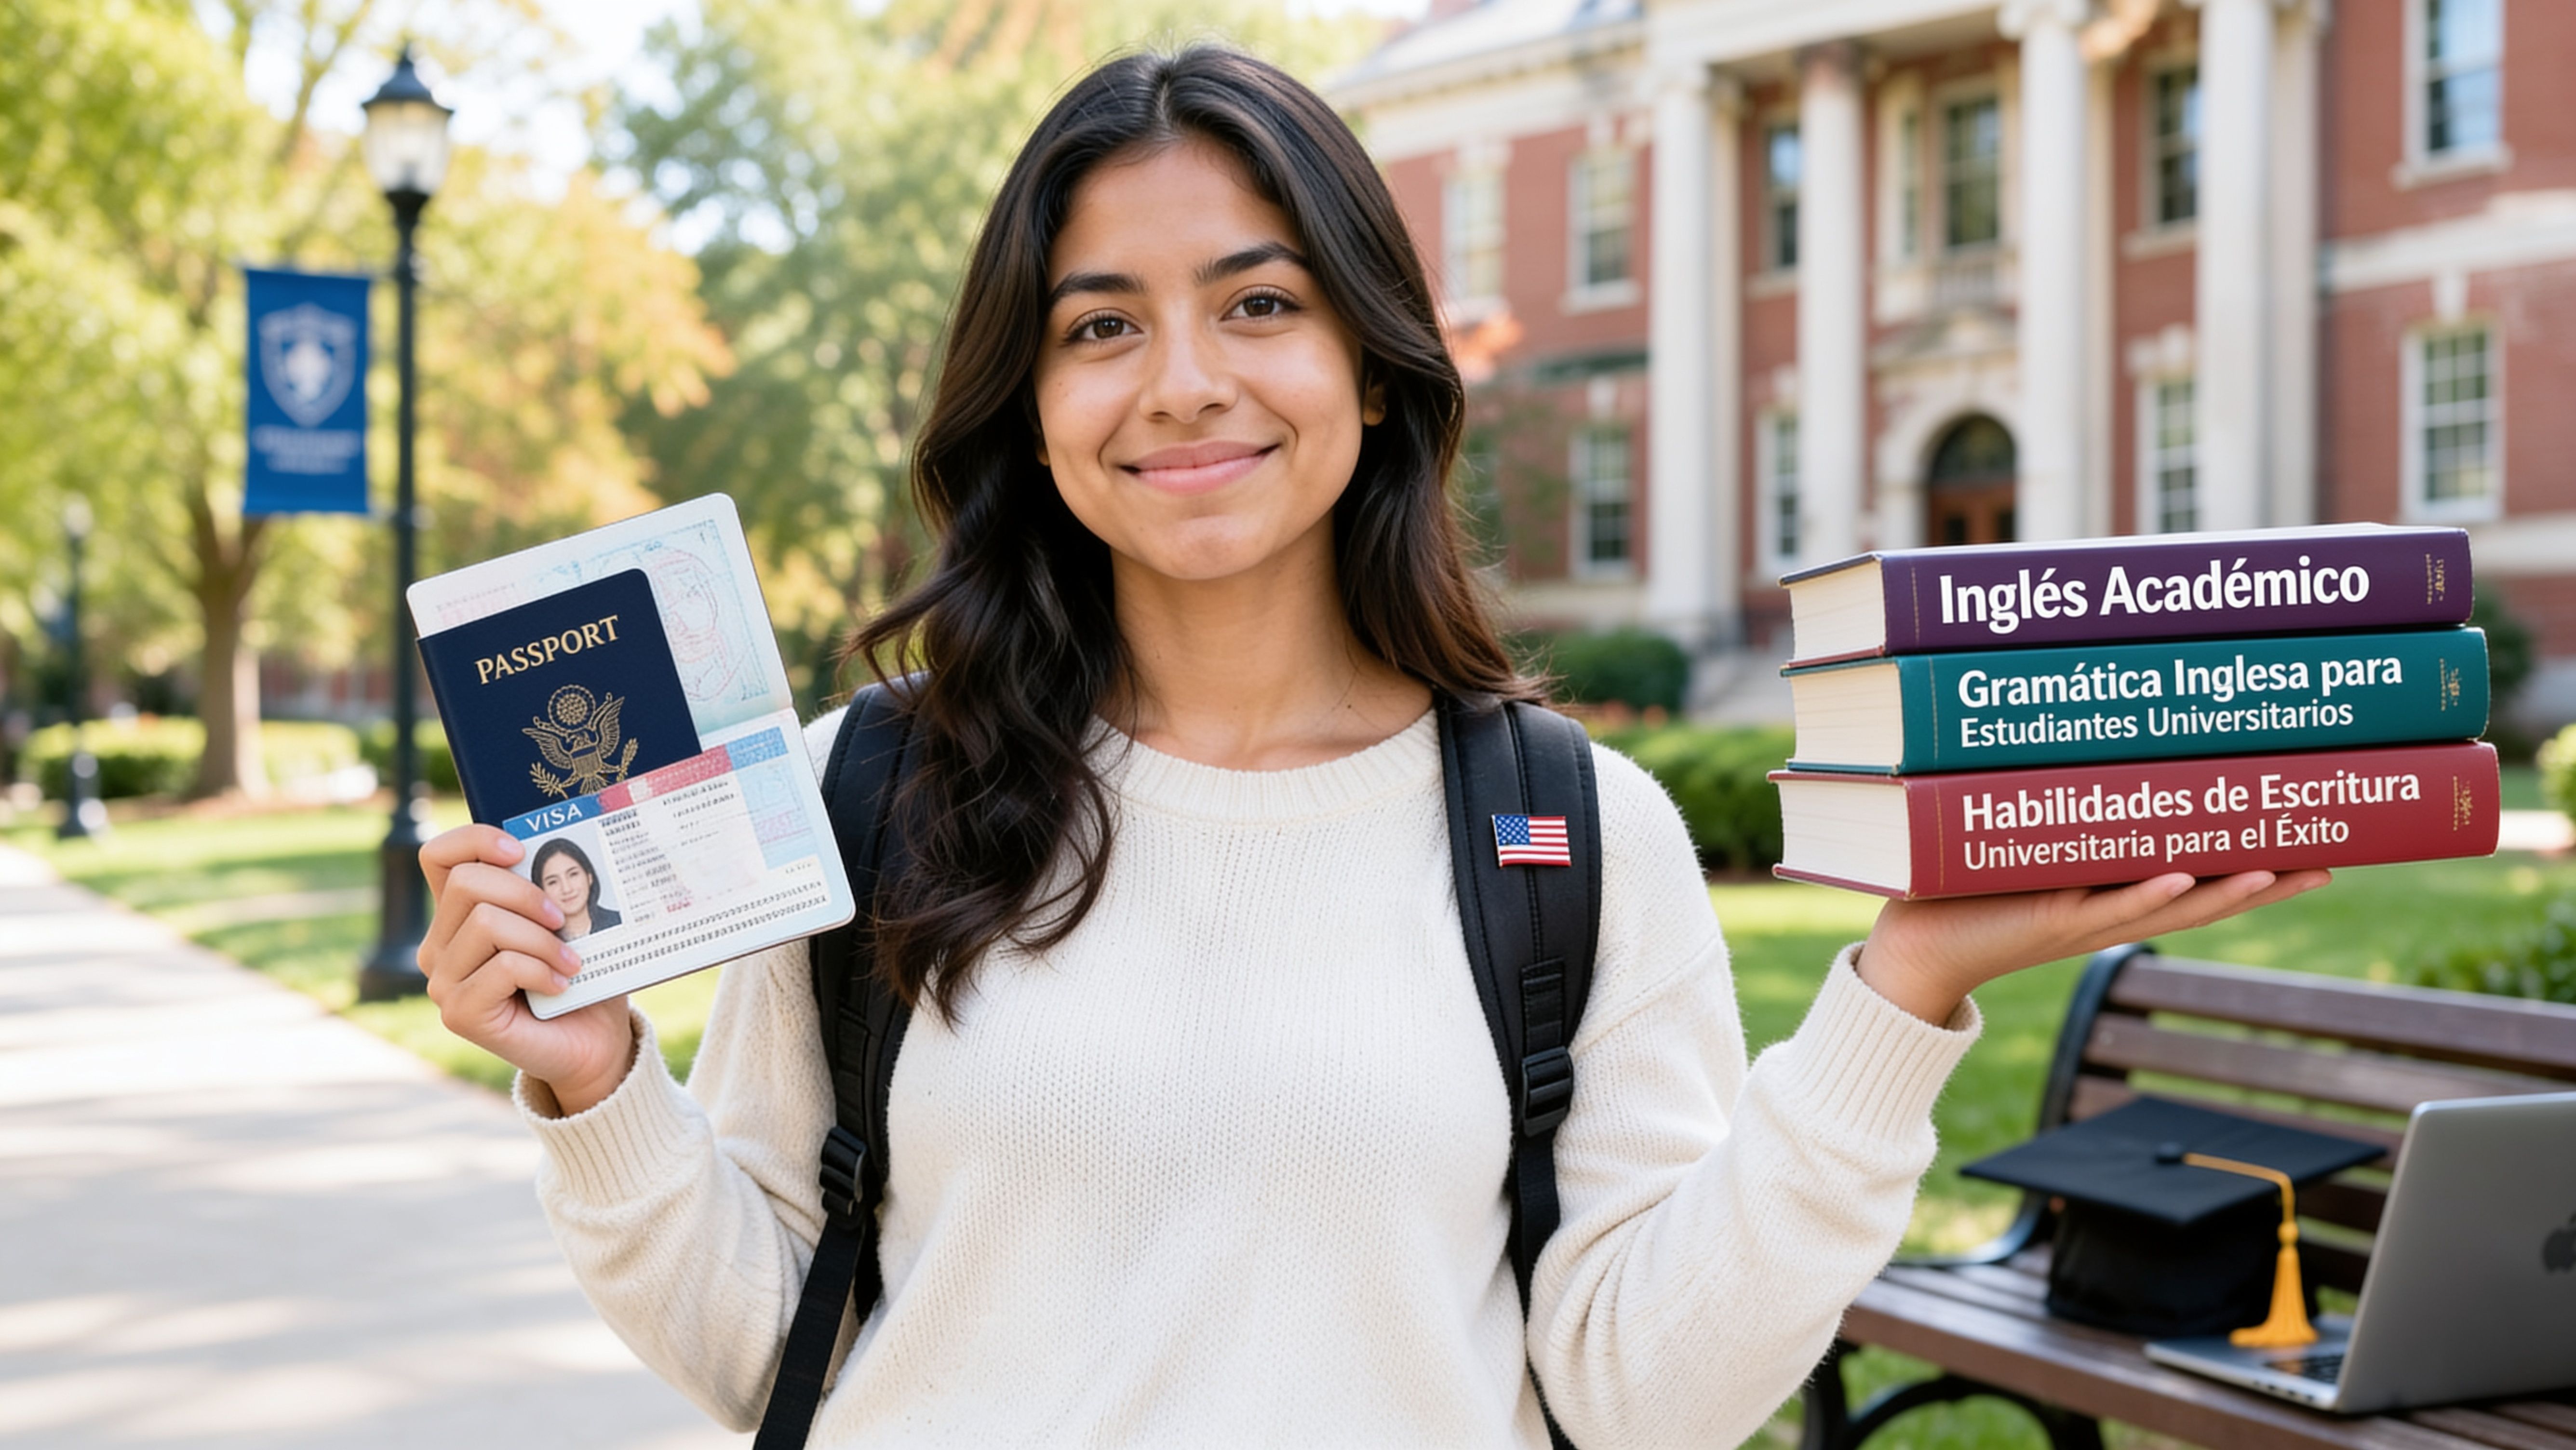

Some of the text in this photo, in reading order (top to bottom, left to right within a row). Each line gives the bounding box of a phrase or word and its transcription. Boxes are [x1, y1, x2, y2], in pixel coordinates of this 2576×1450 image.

[1939, 567, 2089, 634] Inglés
[2099, 555, 2370, 616] Académico
[473, 614, 619, 685] PASSPORT
[1958, 662, 2163, 708] Gramática
[2174, 654, 2309, 703] Inglesa
[2321, 657, 2402, 697] para
[1960, 698, 2353, 748] Estudiantes Universitarios
[524, 802, 583, 832] VISA
[1962, 781, 2194, 832] Habilidades
[2203, 776, 2249, 814] de
[2260, 769, 2421, 810] Escritura
[1964, 812, 2349, 870] Universitaria para el Éxito
